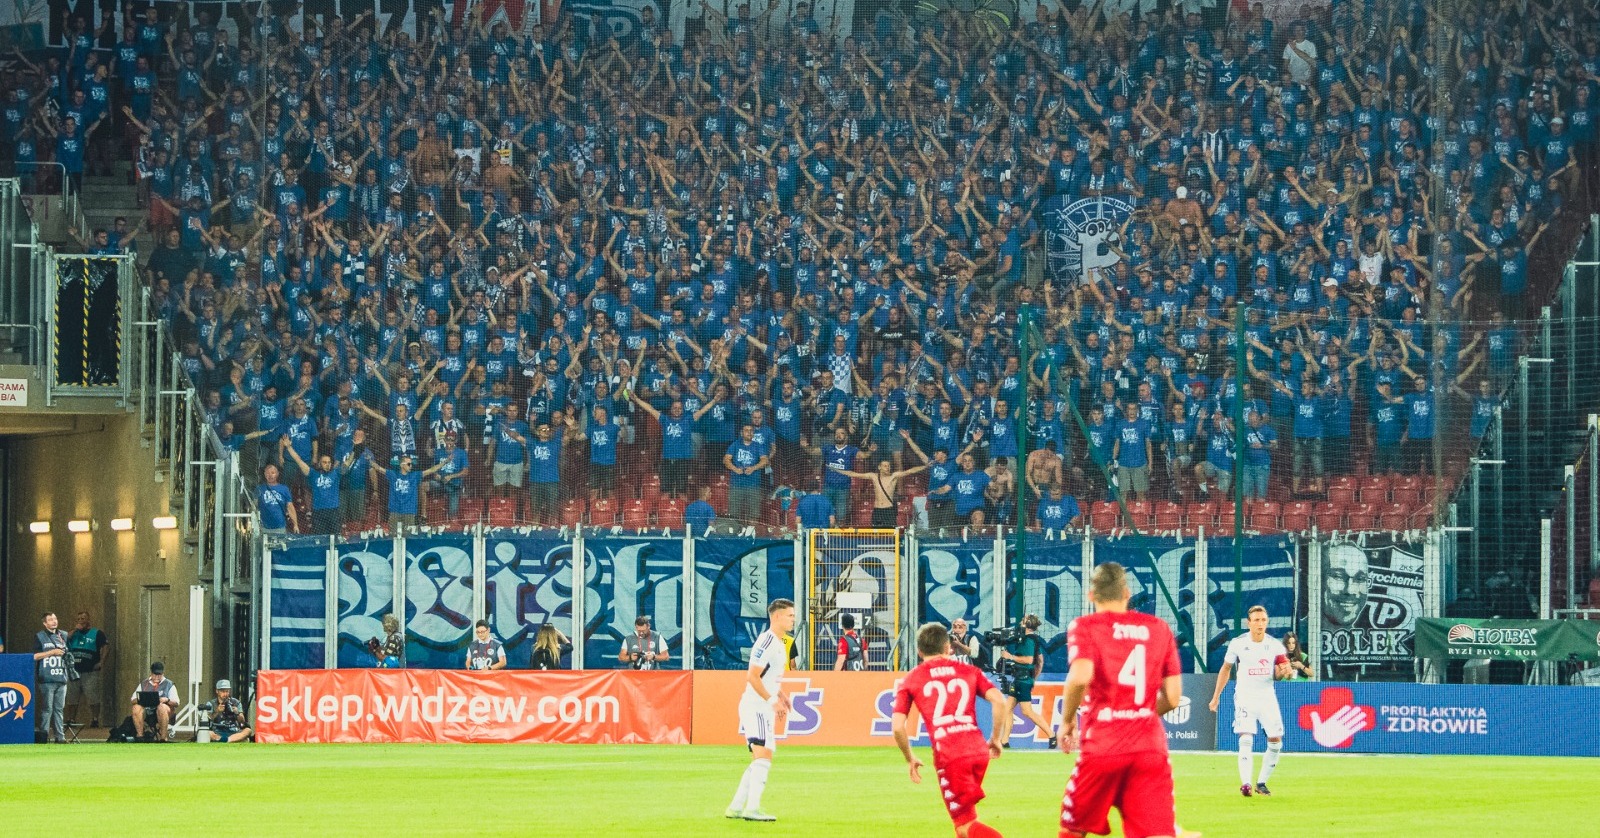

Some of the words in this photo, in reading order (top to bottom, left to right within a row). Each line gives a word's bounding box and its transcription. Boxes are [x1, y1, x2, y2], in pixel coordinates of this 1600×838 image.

[1321, 628, 1409, 655] BOLEK
[1473, 628, 1537, 645] HOLBA
[1118, 643, 1147, 706] 4
[0, 690, 17, 710] TO
[257, 686, 620, 730] sklep.widzew.com
[923, 678, 973, 726] 22
[1381, 705, 1487, 717] PROFILAKTYKA
[1175, 731, 1198, 739] Polski
[1387, 717, 1488, 734] ZDROWIE
